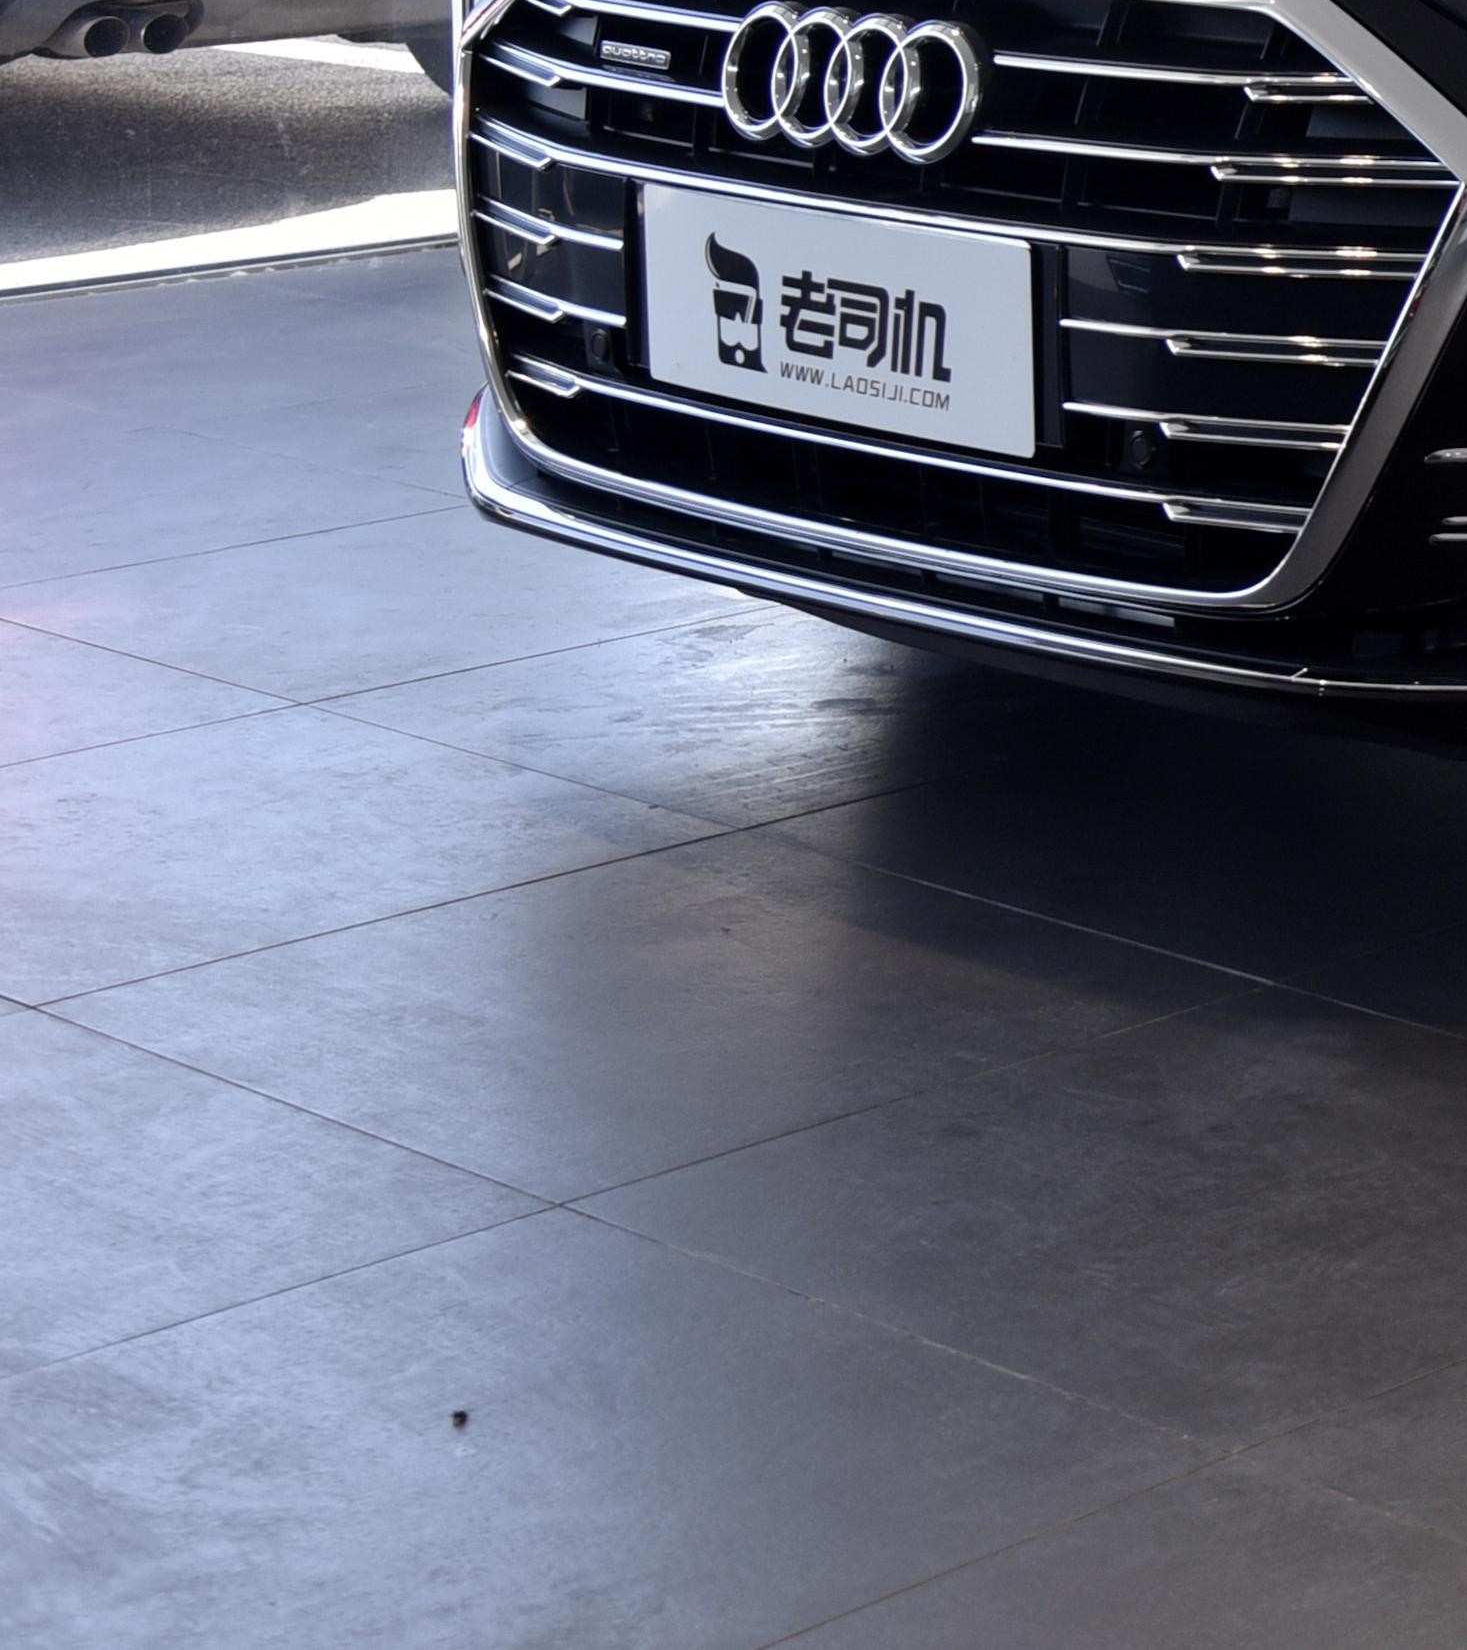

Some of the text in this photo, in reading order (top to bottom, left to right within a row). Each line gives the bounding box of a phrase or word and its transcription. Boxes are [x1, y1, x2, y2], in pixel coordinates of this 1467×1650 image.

[602, 45, 667, 64] quattro
[779, 269, 952, 383] 老司机
[779, 360, 951, 412] WWW.LAOSIJI.COM
